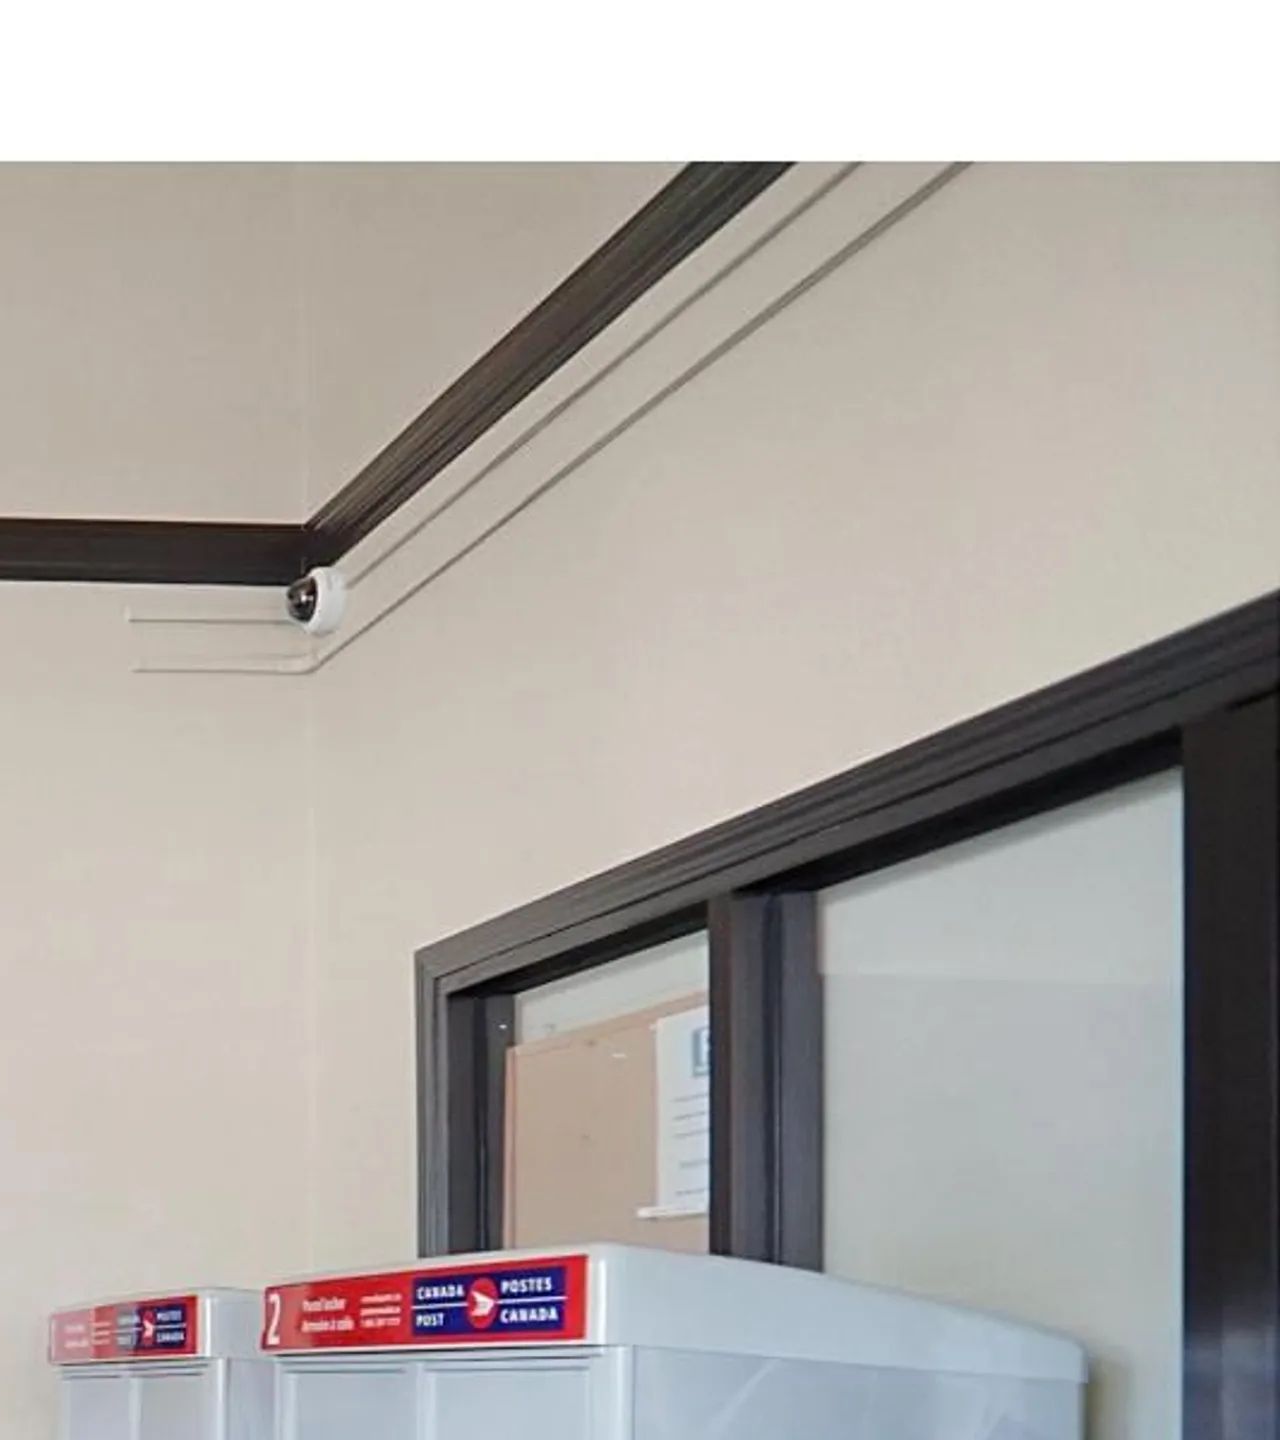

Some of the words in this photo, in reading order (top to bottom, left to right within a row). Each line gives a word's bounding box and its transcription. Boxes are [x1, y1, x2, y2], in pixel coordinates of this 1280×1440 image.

[416, 1284, 465, 1300] CANADA
[500, 1276, 553, 1293] POSTES
[267, 1293, 281, 1346] 2
[415, 1312, 445, 1327] POST
[499, 1307, 559, 1323] CANADA
